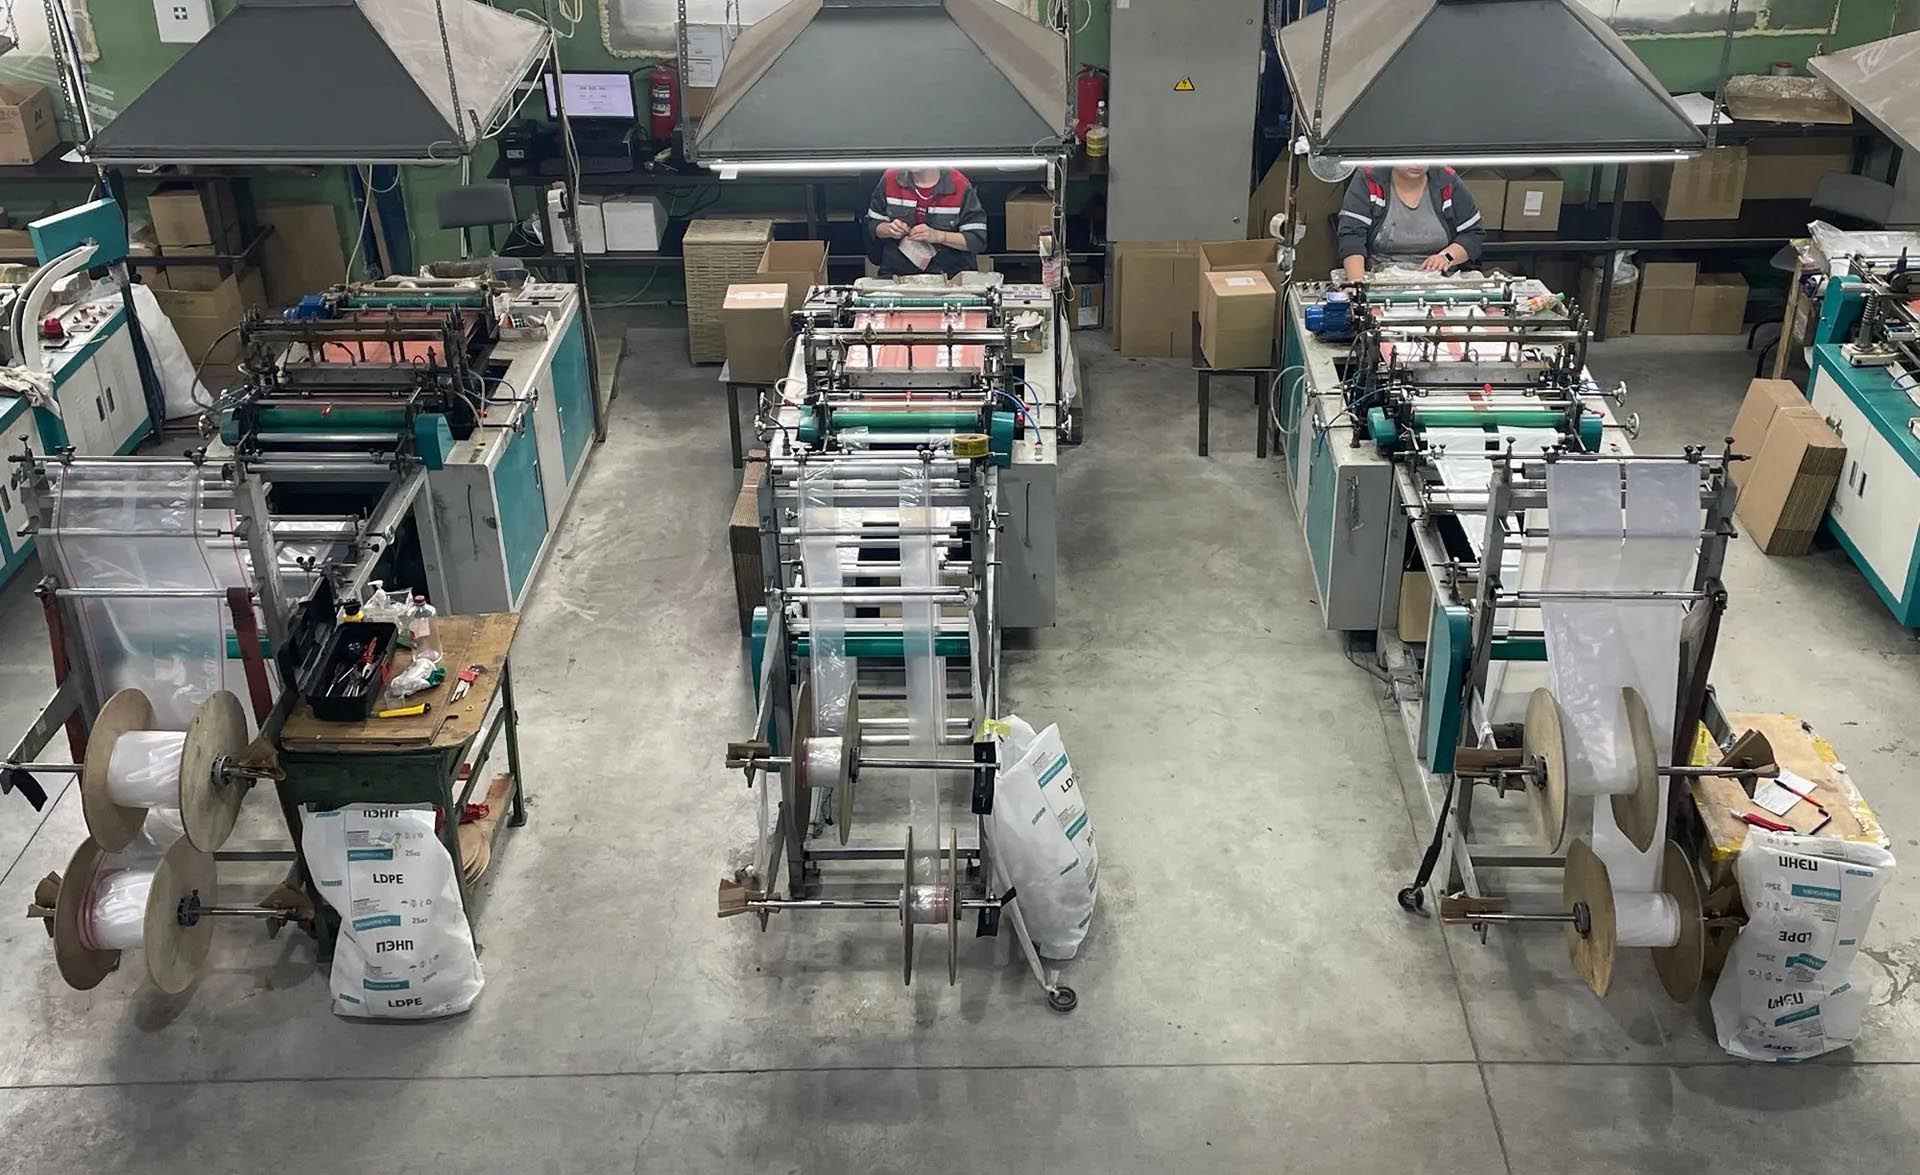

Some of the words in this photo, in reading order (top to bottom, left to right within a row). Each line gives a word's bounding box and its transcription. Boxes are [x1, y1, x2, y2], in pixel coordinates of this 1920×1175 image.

[1778, 855, 1818, 871] ПЭНП
[373, 873, 404, 884] LDPE
[1778, 931, 1812, 943] LDPE
[376, 939, 414, 953] ПЭНП
[387, 997, 423, 1008] LDPE
[1767, 992, 1804, 1009] ПЭНП
